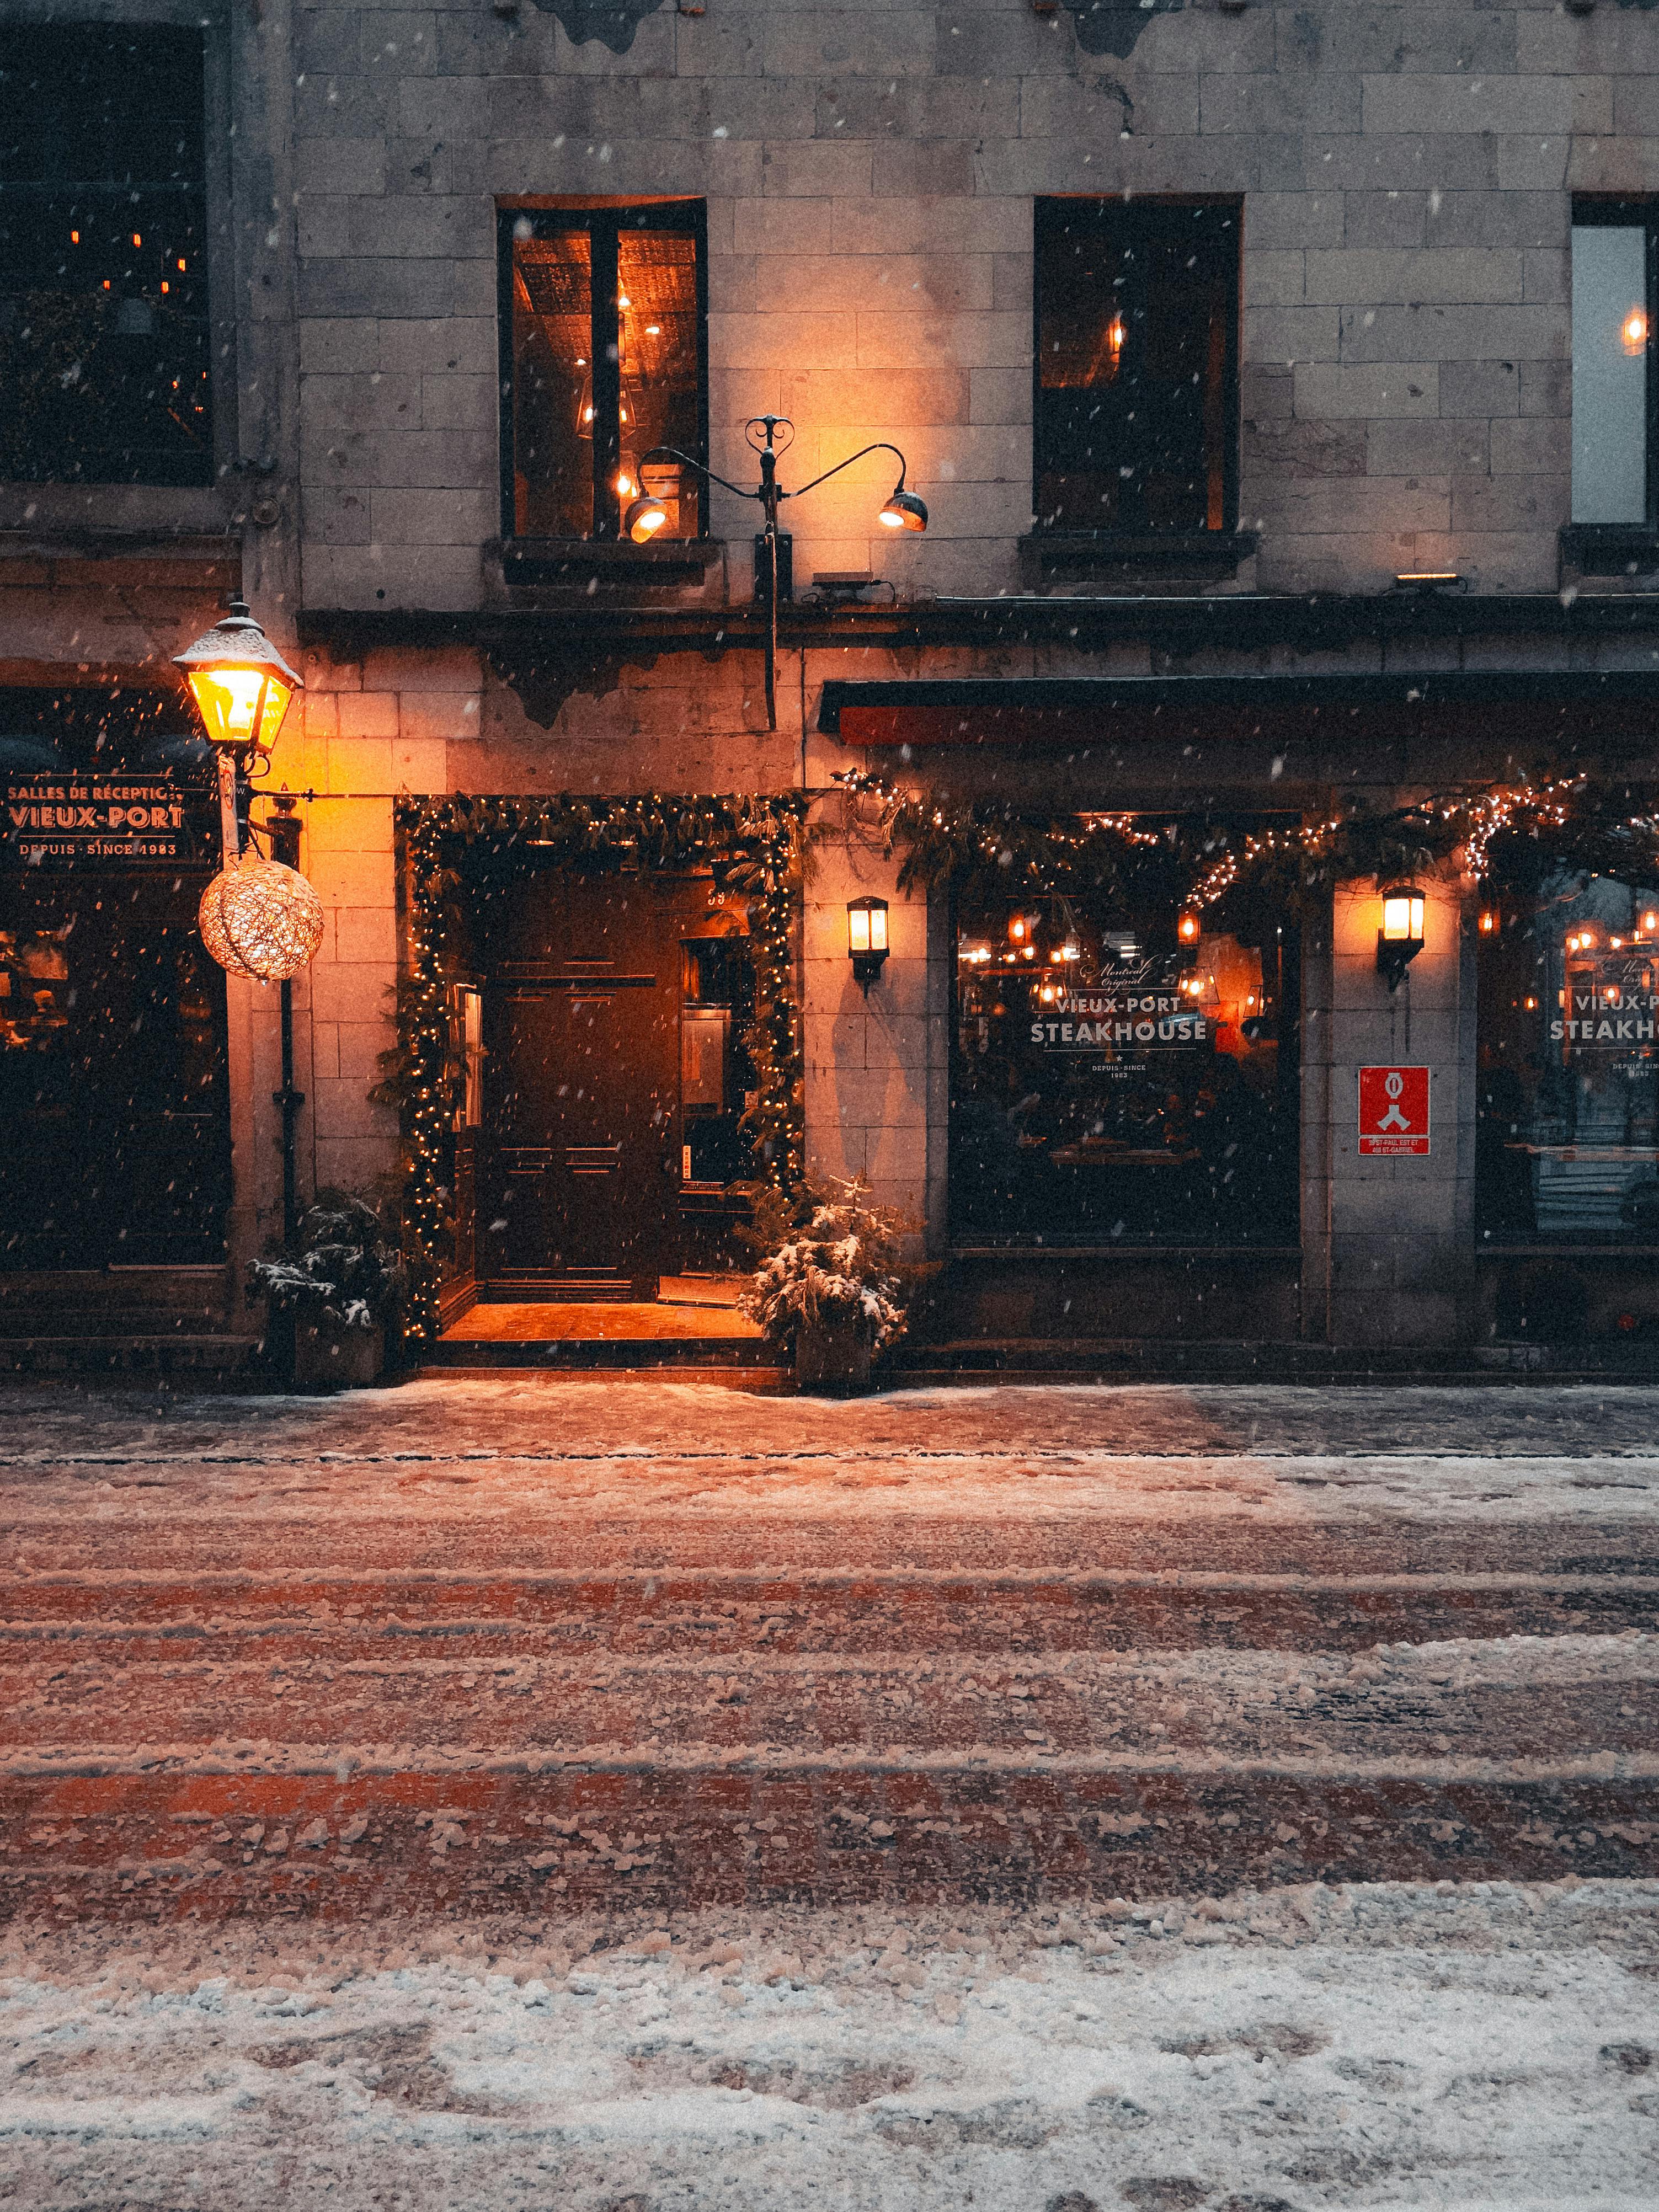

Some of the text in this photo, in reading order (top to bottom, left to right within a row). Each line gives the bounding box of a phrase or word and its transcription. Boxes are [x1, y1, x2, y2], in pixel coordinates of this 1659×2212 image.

[8, 787, 65, 800] SALLES
[70, 787, 89, 800] DE
[8, 806, 185, 829] VIEUX-PORT
[20, 844, 75, 855] DEPUIS
[87, 844, 132, 855] SINCE
[1055, 997, 1181, 1013] VIEUX-PORT
[1031, 1021, 1206, 1043] STEAKHOUSE
[1550, 1020, 1659, 1039] STEAKH
